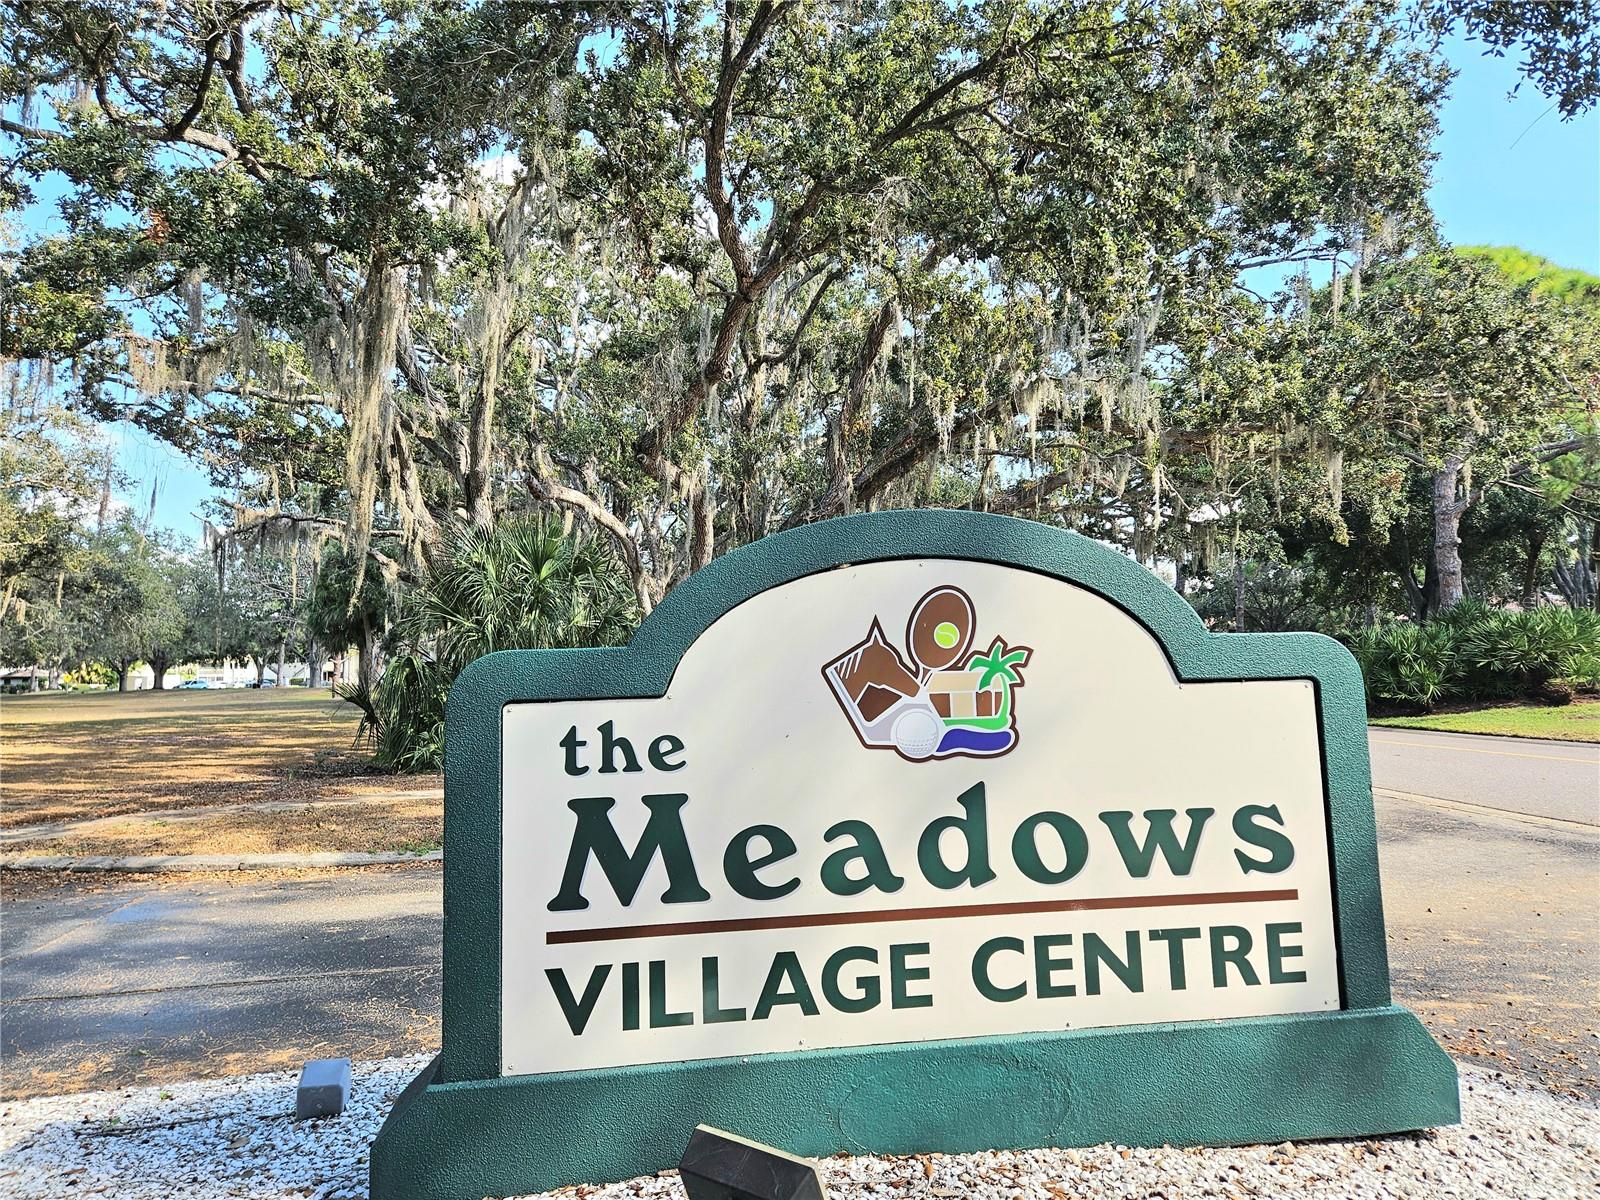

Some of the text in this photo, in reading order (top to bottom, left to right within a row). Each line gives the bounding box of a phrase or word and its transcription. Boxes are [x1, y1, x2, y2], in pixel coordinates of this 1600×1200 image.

[560, 720, 687, 777] the
[547, 781, 1295, 912] Meadows
[544, 922, 1308, 1037] VILLAGE CENTRE
